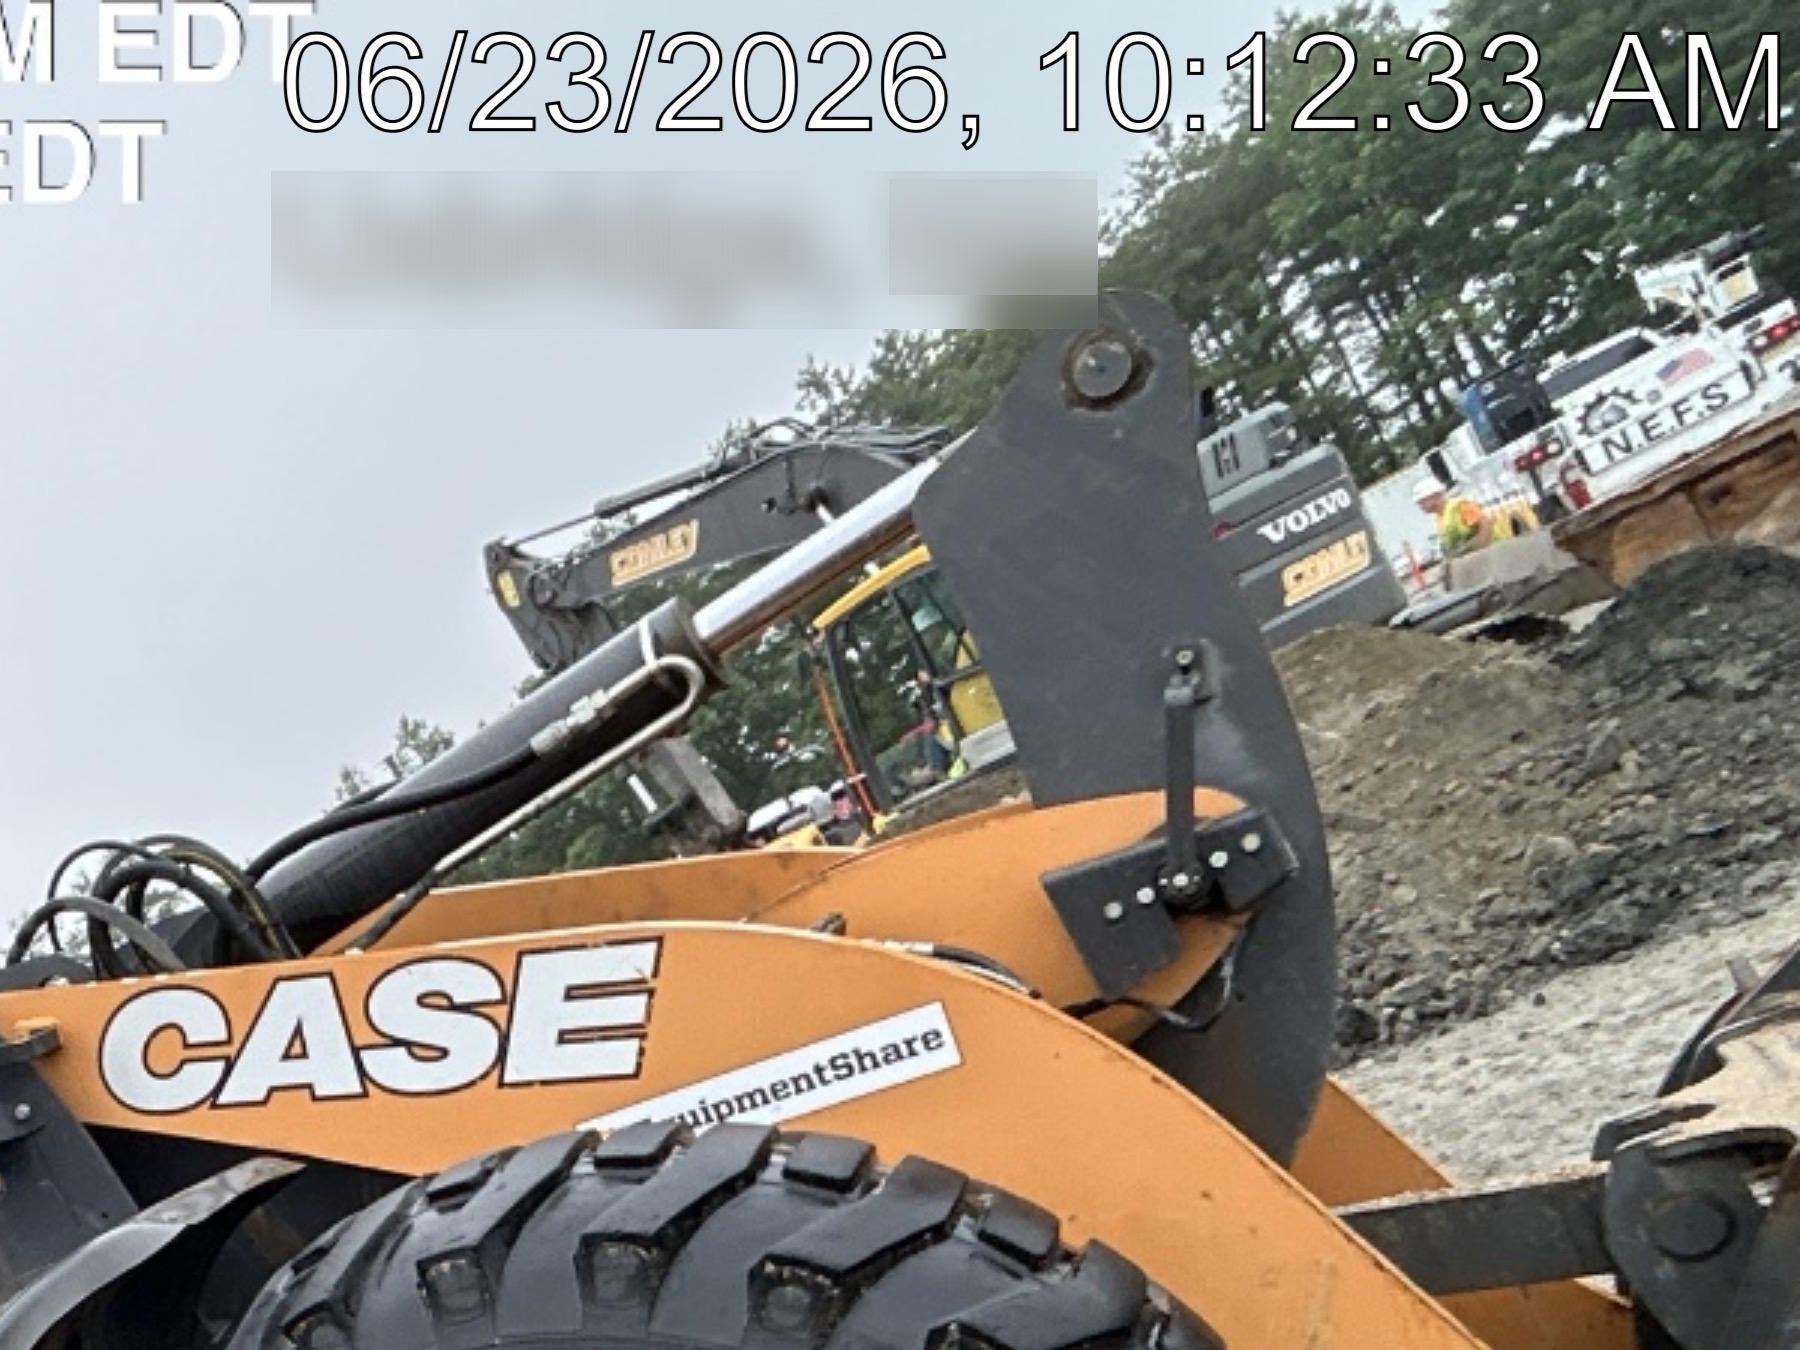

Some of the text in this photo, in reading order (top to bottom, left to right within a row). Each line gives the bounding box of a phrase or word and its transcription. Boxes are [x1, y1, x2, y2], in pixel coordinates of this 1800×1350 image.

[1256, 487, 1352, 544] VOLVO
[99, 935, 664, 1115] CASE
[666, 1026, 946, 1130] uipmentShare
